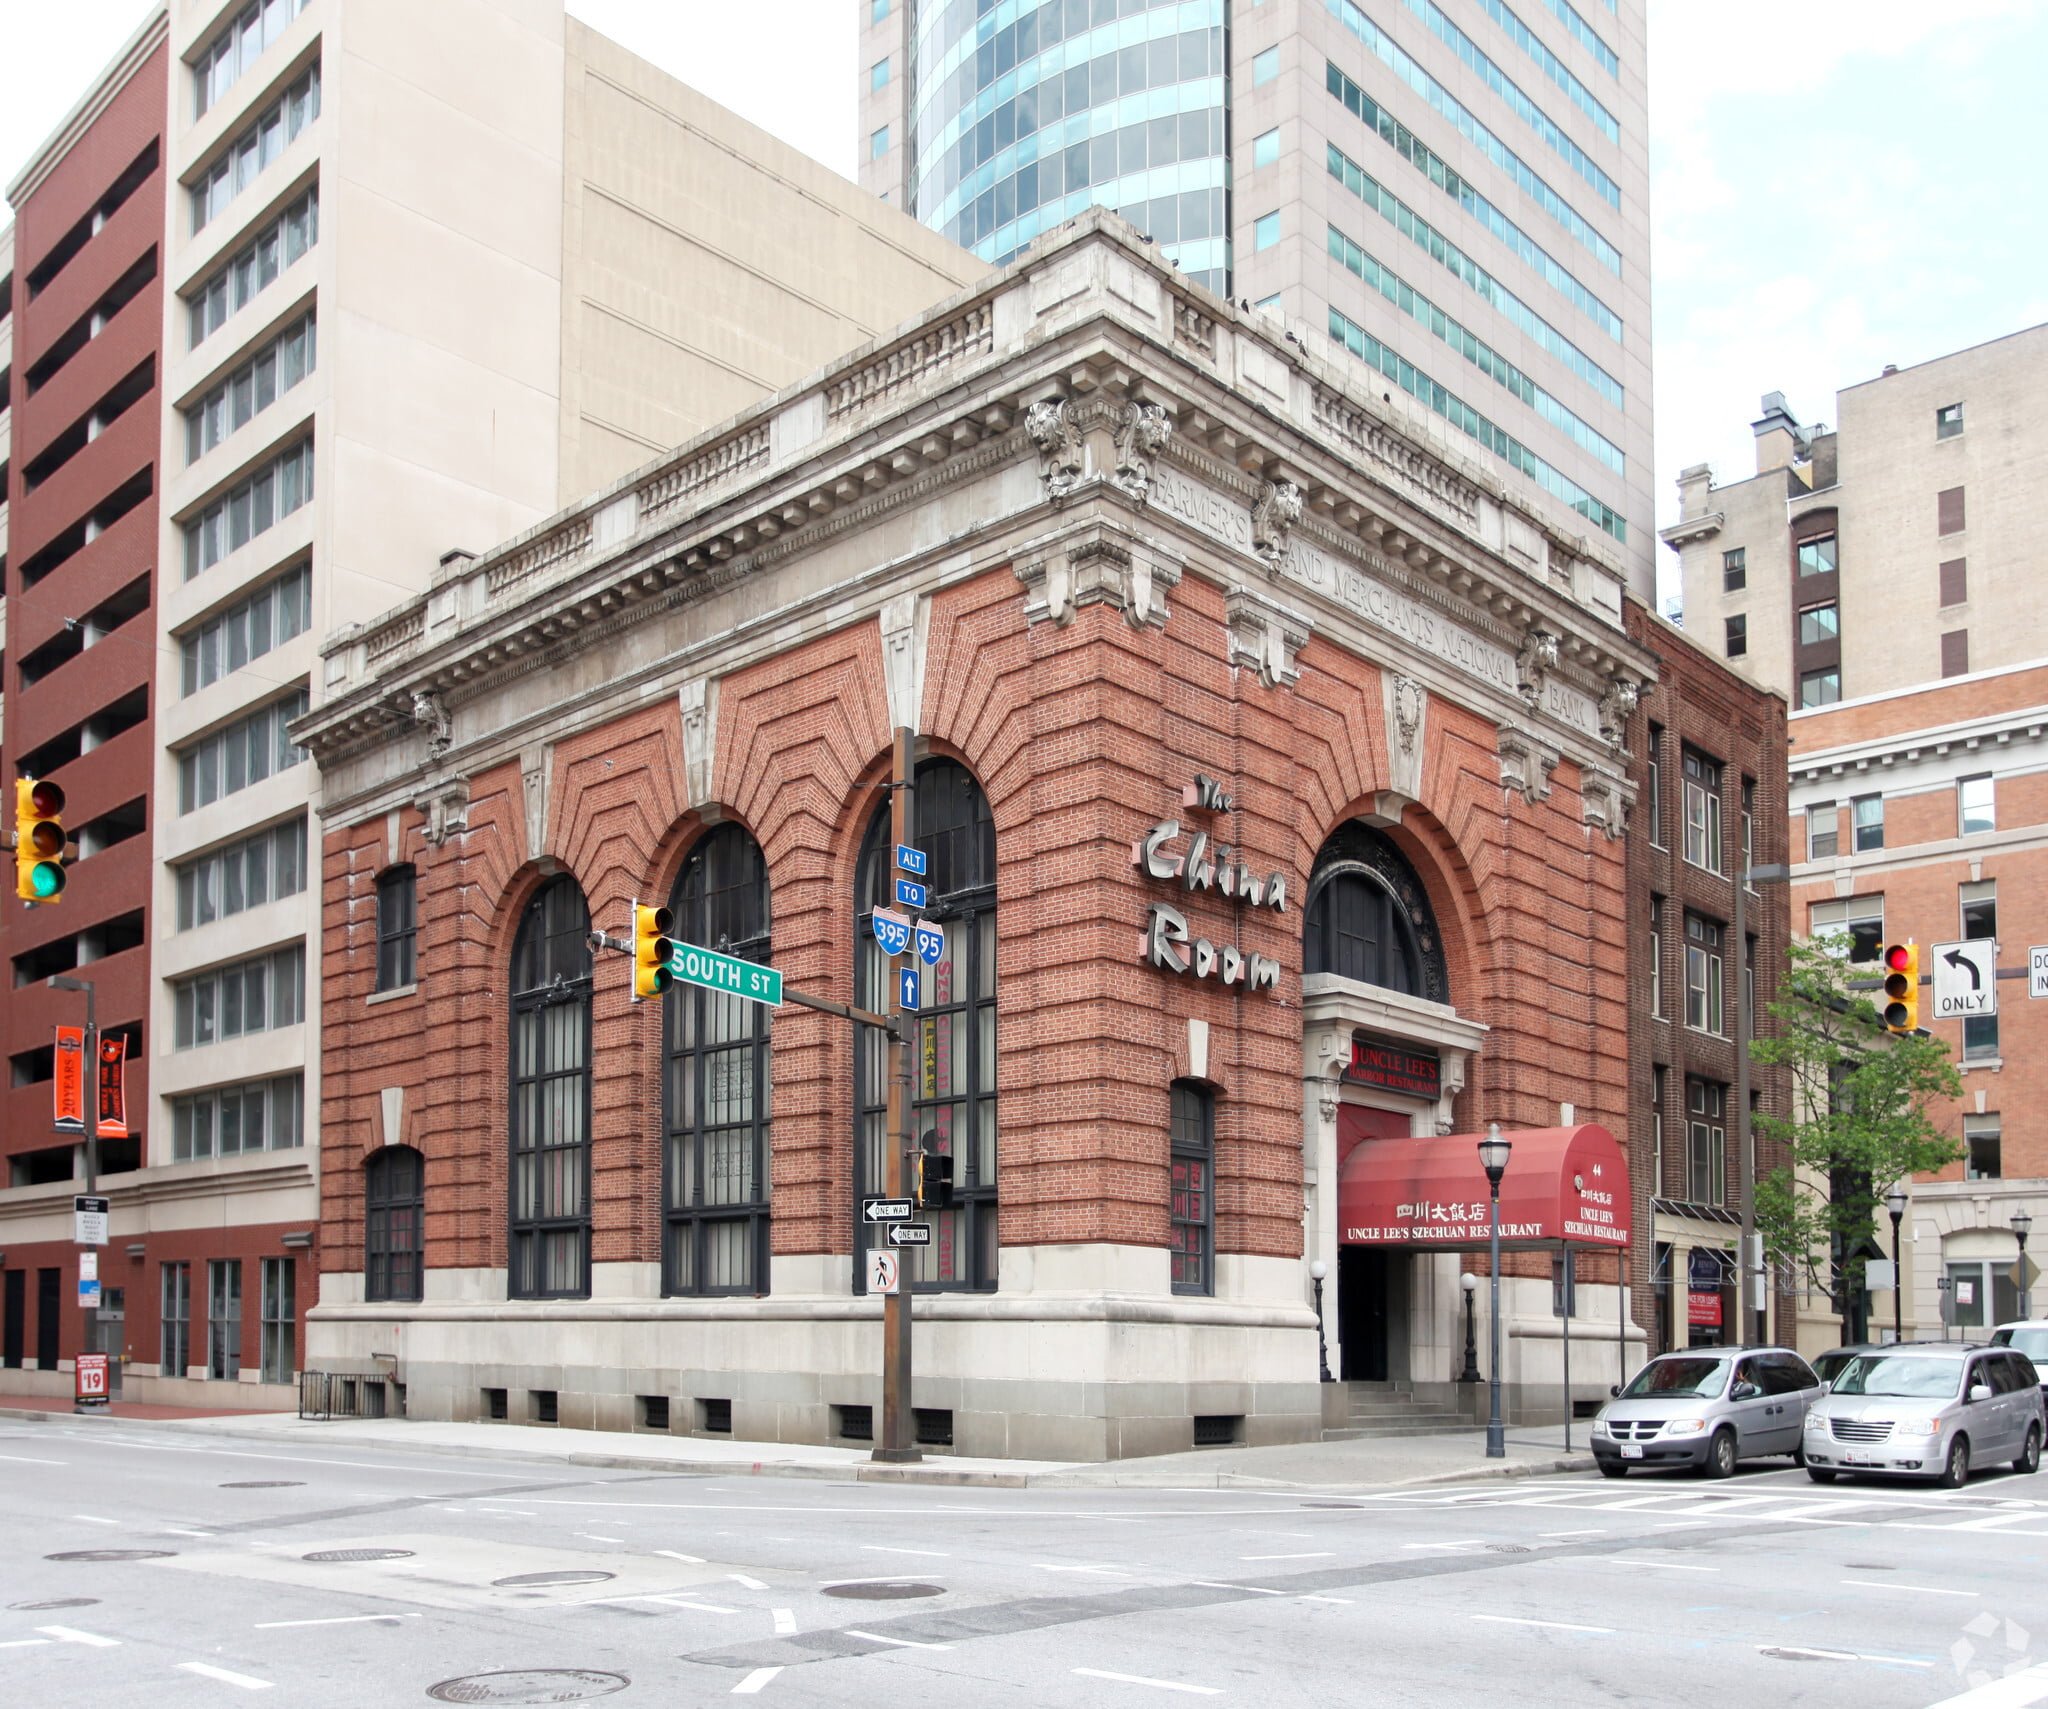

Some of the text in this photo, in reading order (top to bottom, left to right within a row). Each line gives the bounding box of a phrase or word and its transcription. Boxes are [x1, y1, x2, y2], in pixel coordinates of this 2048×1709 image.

[1154, 472, 1586, 727] FARMER'S AND MERCHANTS NATIONAL BANK
[1194, 772, 1233, 812] The
[903, 852, 921, 868] ALT
[1140, 818, 1286, 913] China
[903, 885, 918, 901] TO
[877, 921, 906, 948] 395
[919, 933, 940, 957] 95
[1147, 902, 1281, 991] Room
[671, 948, 771, 994] SOUTH ST
[1942, 994, 1986, 1012] ONLY
[1360, 1046, 1438, 1080] UNCLE LEE'S
[63, 1059, 75, 1097] YEARS
[1386, 1074, 1439, 1095] RESTAURANT
[1592, 1164, 1601, 1177] 44
[875, 1205, 908, 1216] ONE WAY
[1396, 1200, 1487, 1223] 四川大飯店
[1580, 1206, 1614, 1224] UNCLE LEE'S
[898, 1230, 928, 1240] ONE WAY
[1348, 1227, 1380, 1240] UNCLE
[1383, 1226, 1409, 1239] LEE'S
[1412, 1225, 1465, 1239] SZECHUAN
[1564, 1220, 1627, 1242] SZECHUAN RESTAURANT
